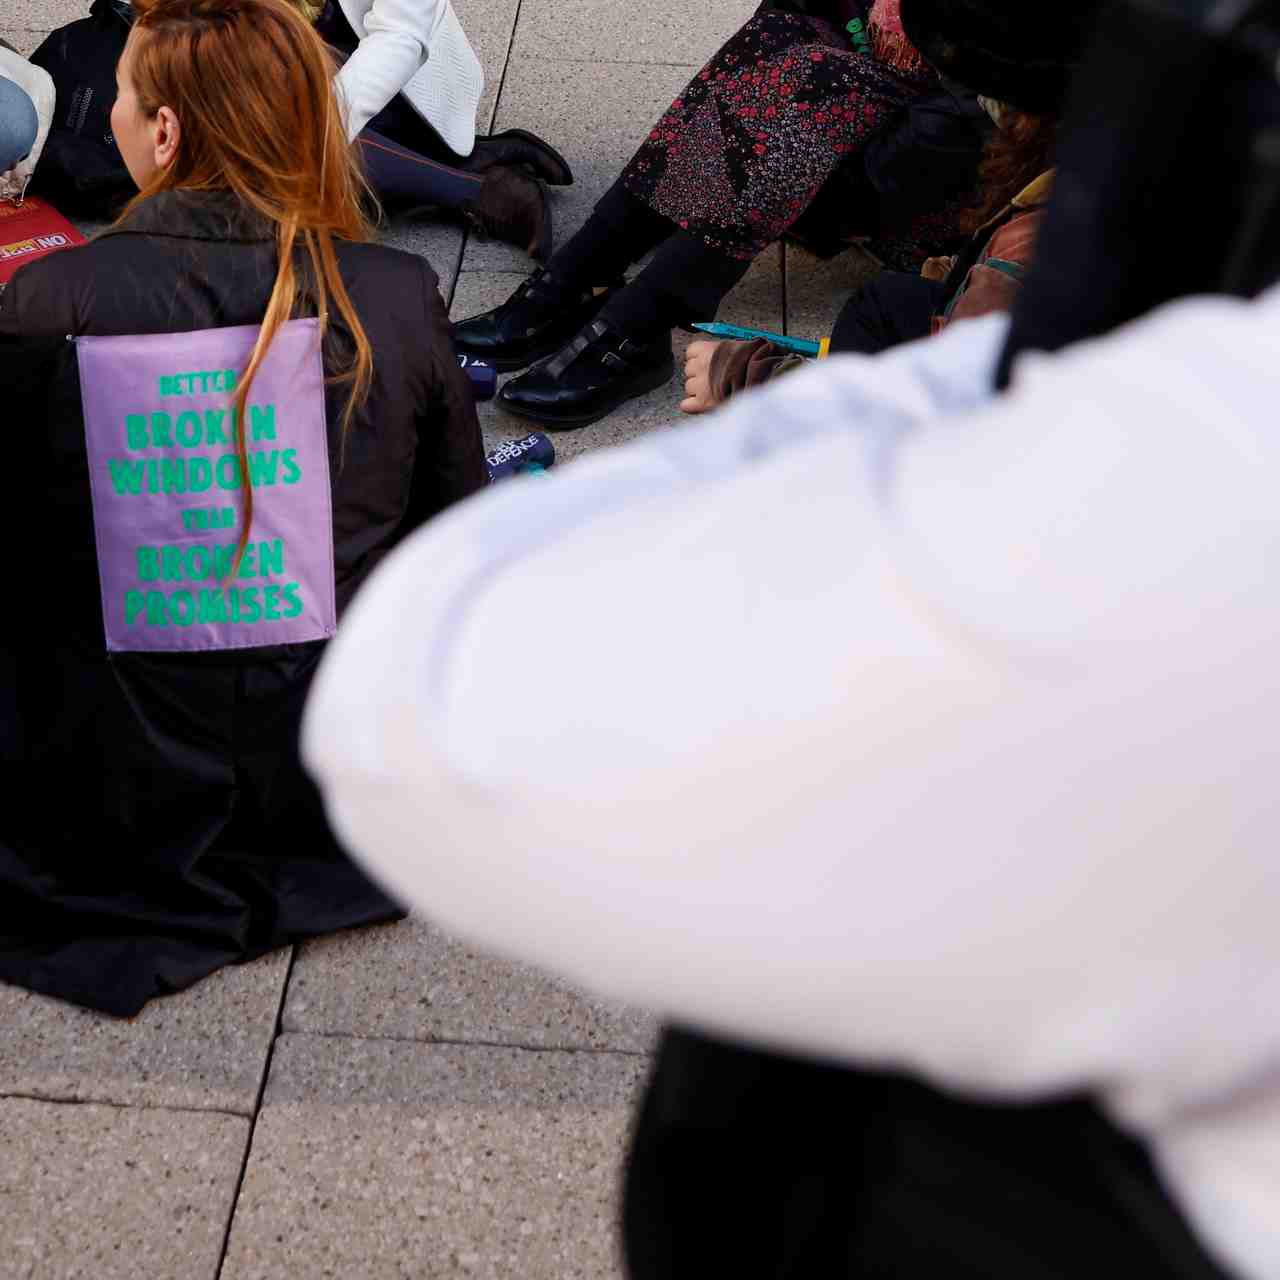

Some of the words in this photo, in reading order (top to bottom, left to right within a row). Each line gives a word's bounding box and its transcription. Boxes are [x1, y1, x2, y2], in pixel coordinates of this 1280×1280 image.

[159, 369, 237, 397] BETTER
[106, 448, 302, 496] WINDOWS
[486, 434, 539, 467] DEFENCE
[135, 538, 286, 583] BROKEN
[123, 581, 305, 627] PROMISES
